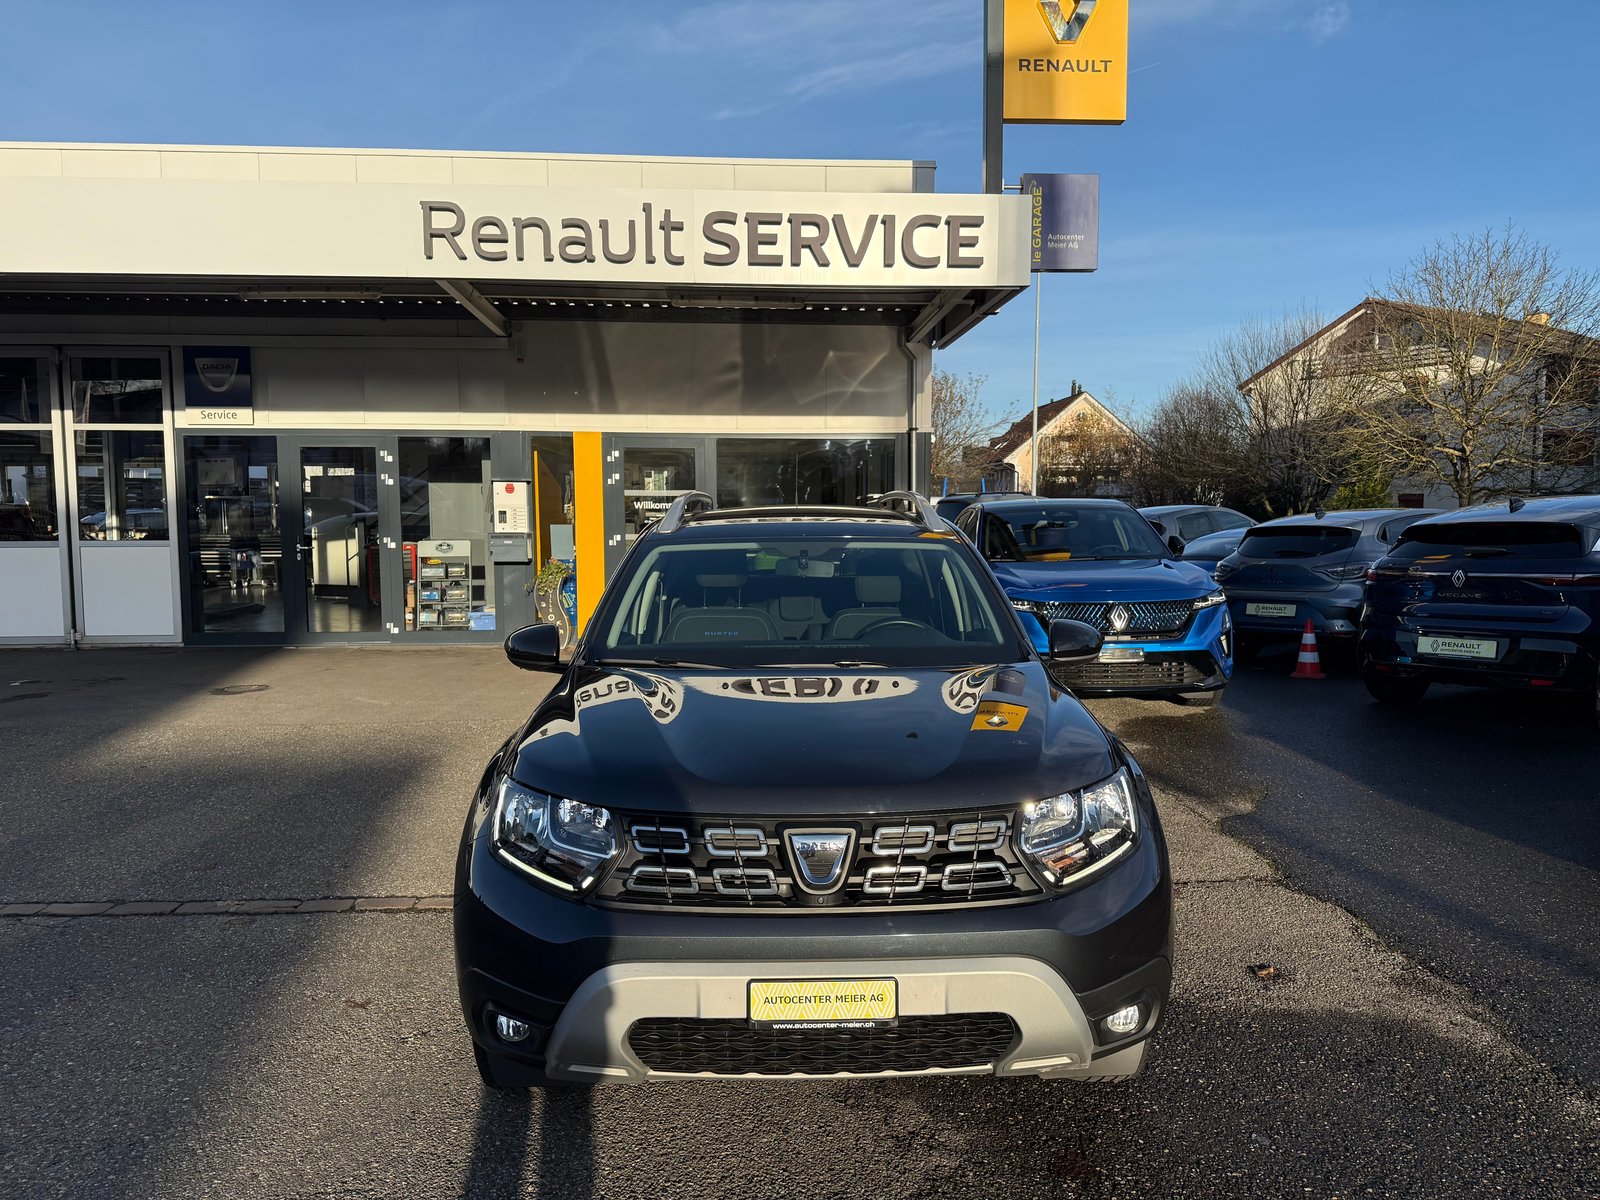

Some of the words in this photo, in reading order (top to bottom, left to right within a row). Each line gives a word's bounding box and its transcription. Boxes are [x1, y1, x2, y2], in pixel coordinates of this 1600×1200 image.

[1018, 58, 1113, 73] RENAULT
[1032, 186, 1043, 248] GARAGE
[419, 200, 686, 266] Renault
[701, 209, 985, 269] SERVICE
[1047, 233, 1085, 241] Autocenter
[1047, 241, 1067, 249] Meier
[1067, 241, 1079, 249] AG
[1032, 251, 1042, 262] le
[200, 409, 238, 420] Service
[633, 500, 687, 510] Willkom
[1441, 640, 1482, 650] RENAULT
[763, 994, 832, 1005] AUTOCENTER
[835, 994, 867, 1004] MEIER
[869, 993, 884, 1003] AG
[772, 1021, 876, 1030] www.autocenter-meier.ch
